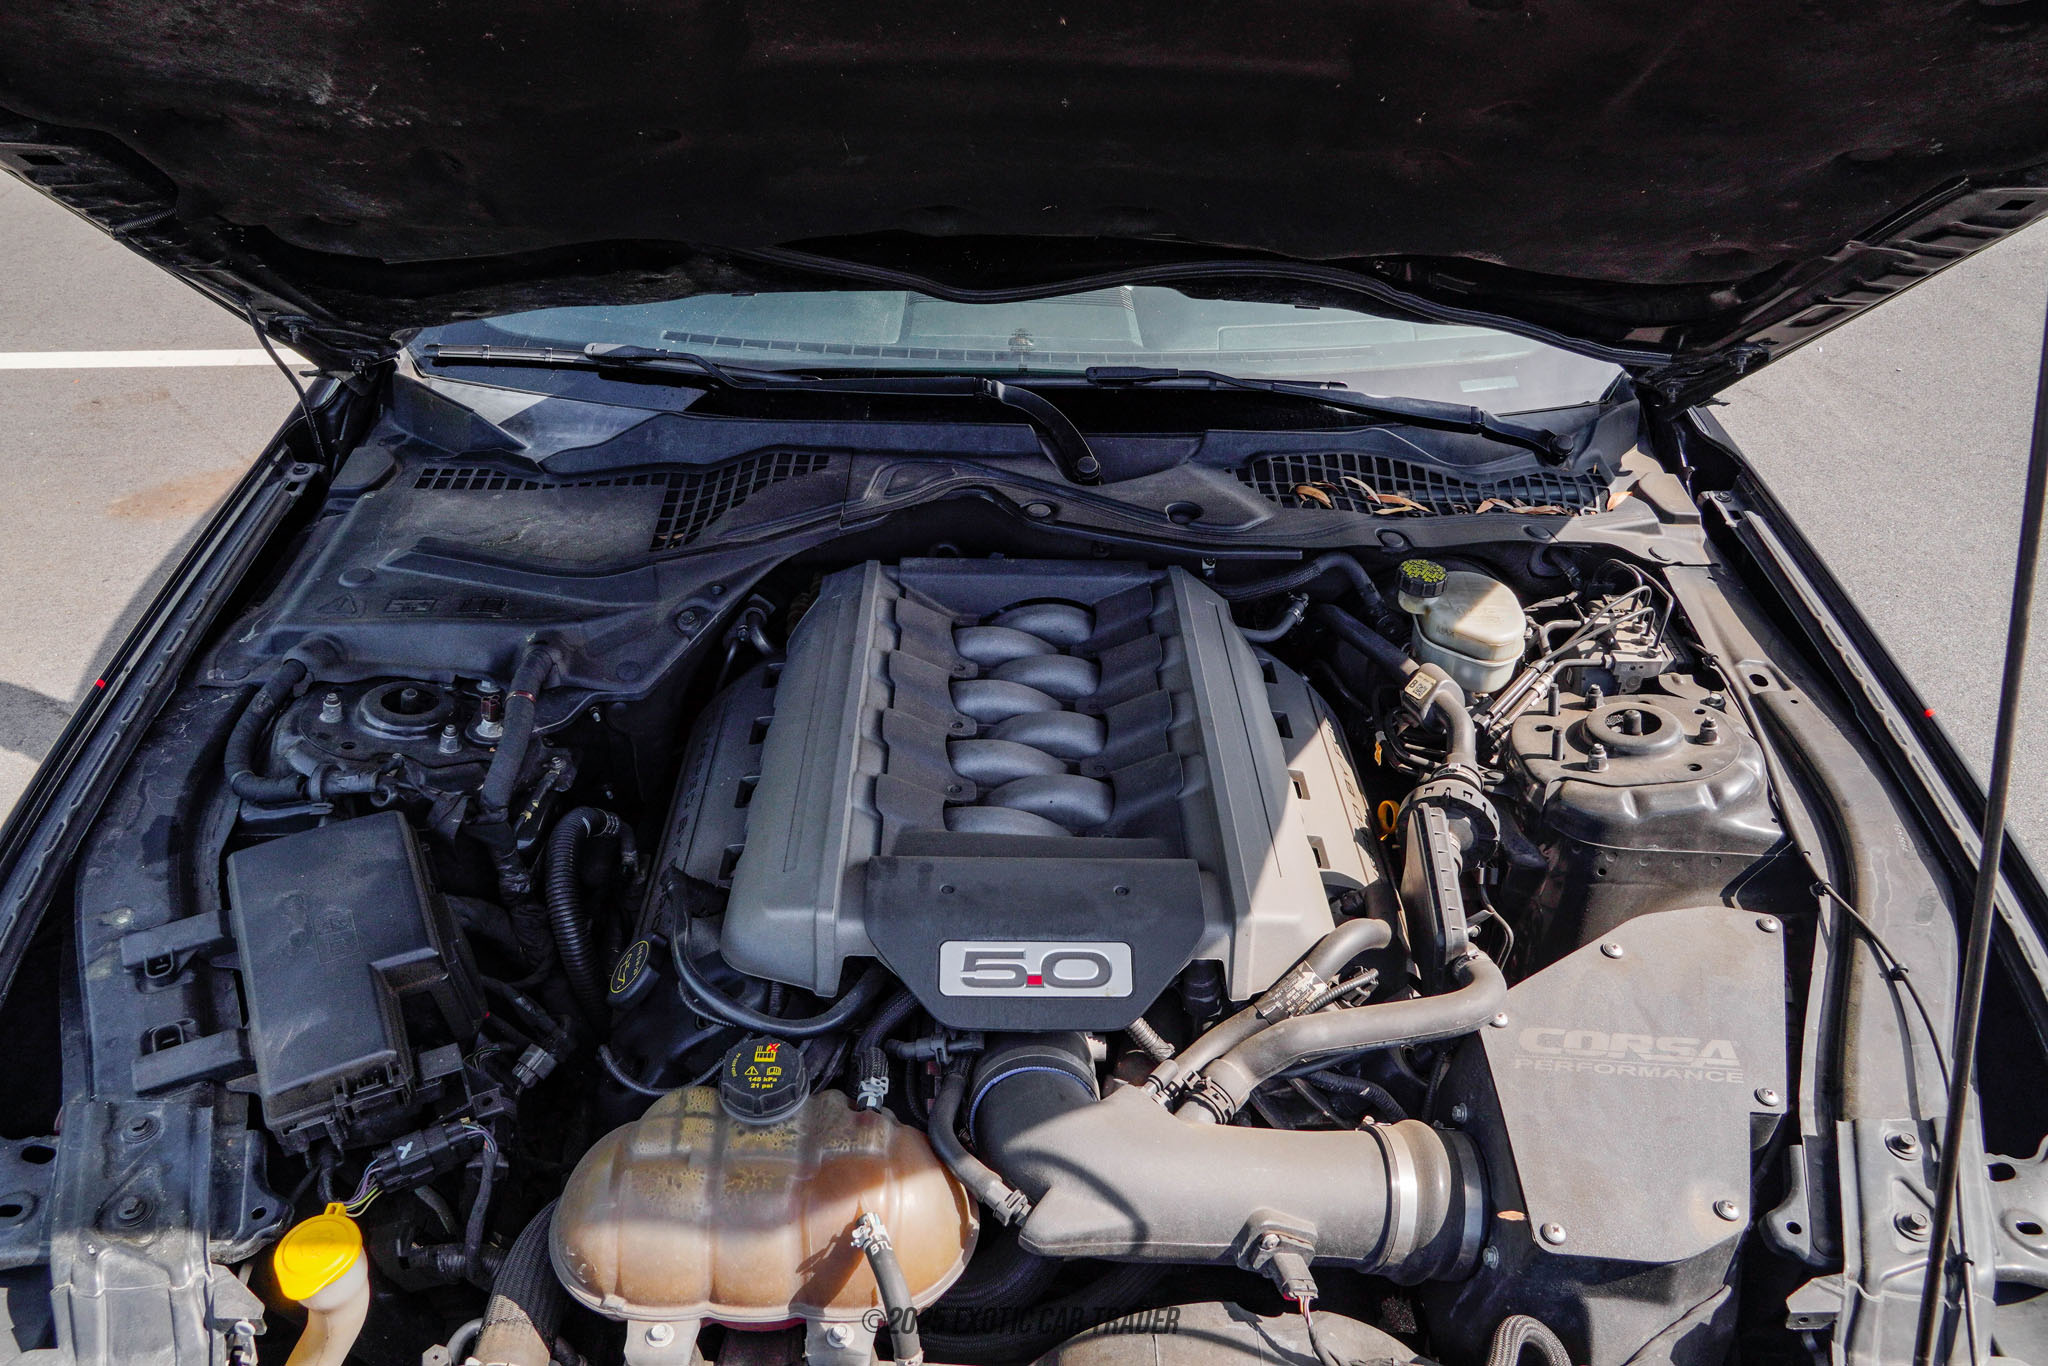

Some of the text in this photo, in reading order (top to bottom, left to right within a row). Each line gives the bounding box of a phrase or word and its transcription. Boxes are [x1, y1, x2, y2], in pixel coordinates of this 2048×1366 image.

[960, 948, 1113, 989] 5.0
[1518, 1027, 1741, 1068] CORSA
[1514, 1058, 1745, 1084] PERFORMANCE
